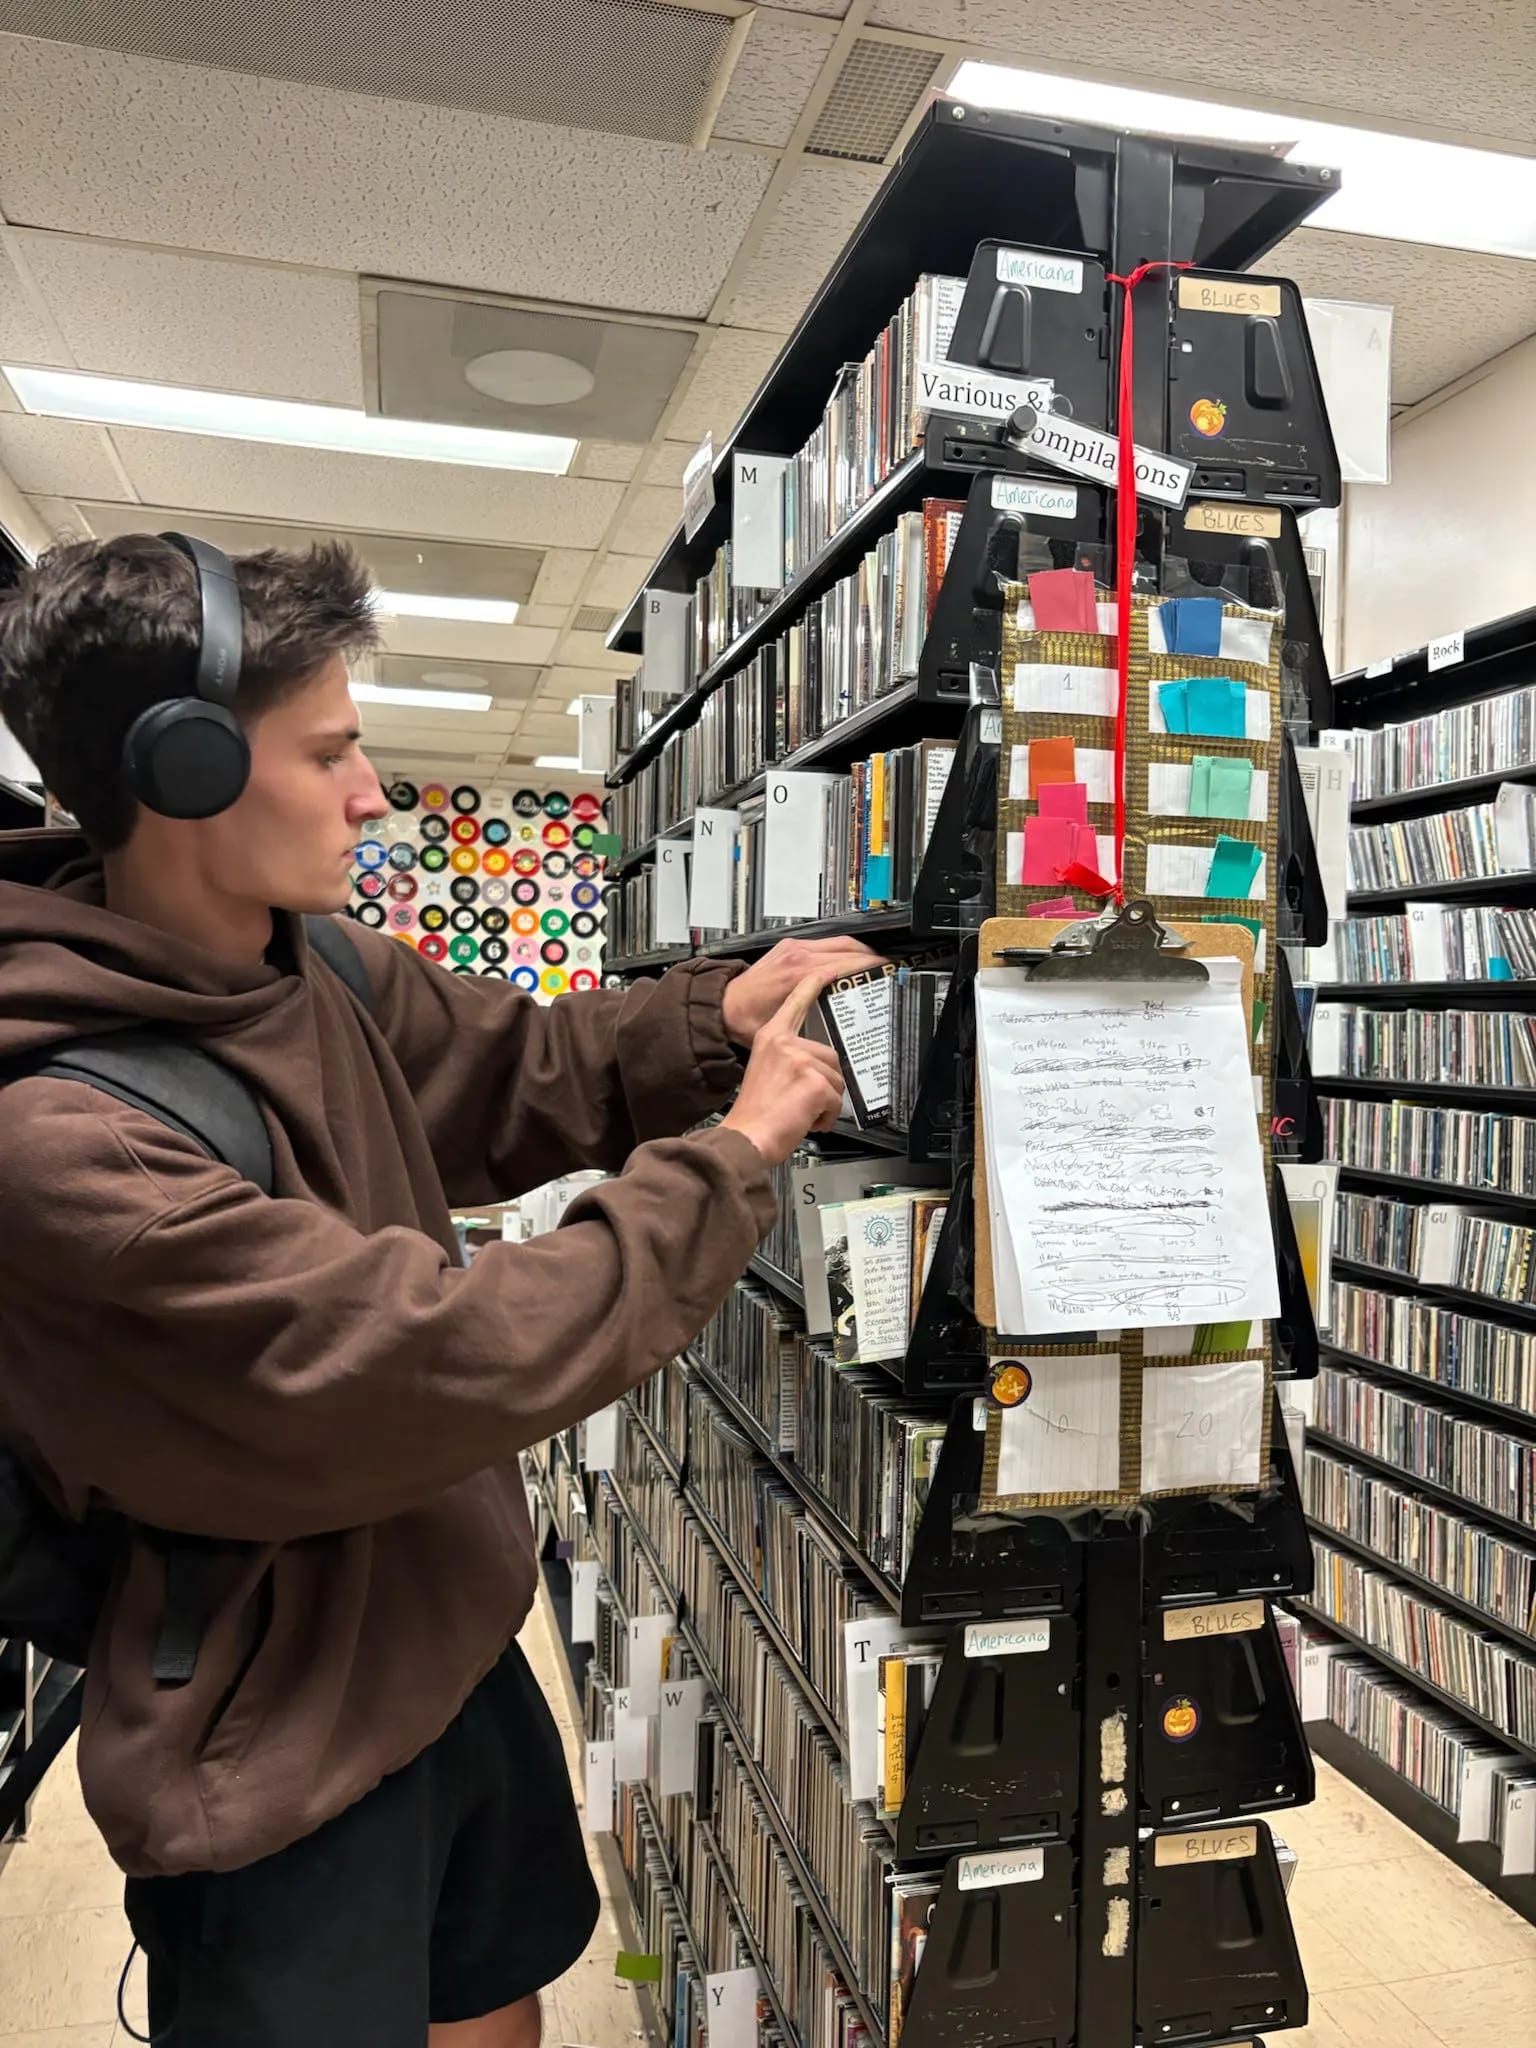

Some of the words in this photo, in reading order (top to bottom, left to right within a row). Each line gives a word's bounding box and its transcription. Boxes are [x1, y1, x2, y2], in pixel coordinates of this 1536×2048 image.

[999, 250, 1074, 286] Americana
[1201, 288, 1260, 311] BLUES
[922, 373, 1017, 411] Various
[1025, 390, 1046, 413] &
[1031, 426, 1181, 489] ompilaons
[741, 466, 758, 484] M
[997, 477, 1074, 508] Americana
[1202, 508, 1264, 532] BLUES
[651, 601, 660, 614] B
[1433, 639, 1460, 661] Rock
[1062, 674, 1073, 691] 1
[584, 703, 593, 714] A
[1328, 769, 1342, 791] H
[773, 785, 788, 804] O
[701, 820, 714, 836] N
[663, 850, 673, 863] C
[559, 1191, 567, 1202] E
[802, 1183, 816, 1205] S
[1176, 1411, 1213, 1438] 20
[634, 1626, 638, 1639] I
[1192, 1611, 1252, 1634] BLUES
[967, 1629, 1046, 1652] Americana
[854, 1640, 871, 1663] T
[1305, 1655, 1319, 1667] HU
[618, 1697, 628, 1709] K
[665, 1691, 683, 1706] W
[590, 1752, 598, 1764] L
[1185, 1835, 1249, 1858] BLUES
[961, 1860, 1037, 1881] Americana
[712, 1986, 724, 2006] Y
